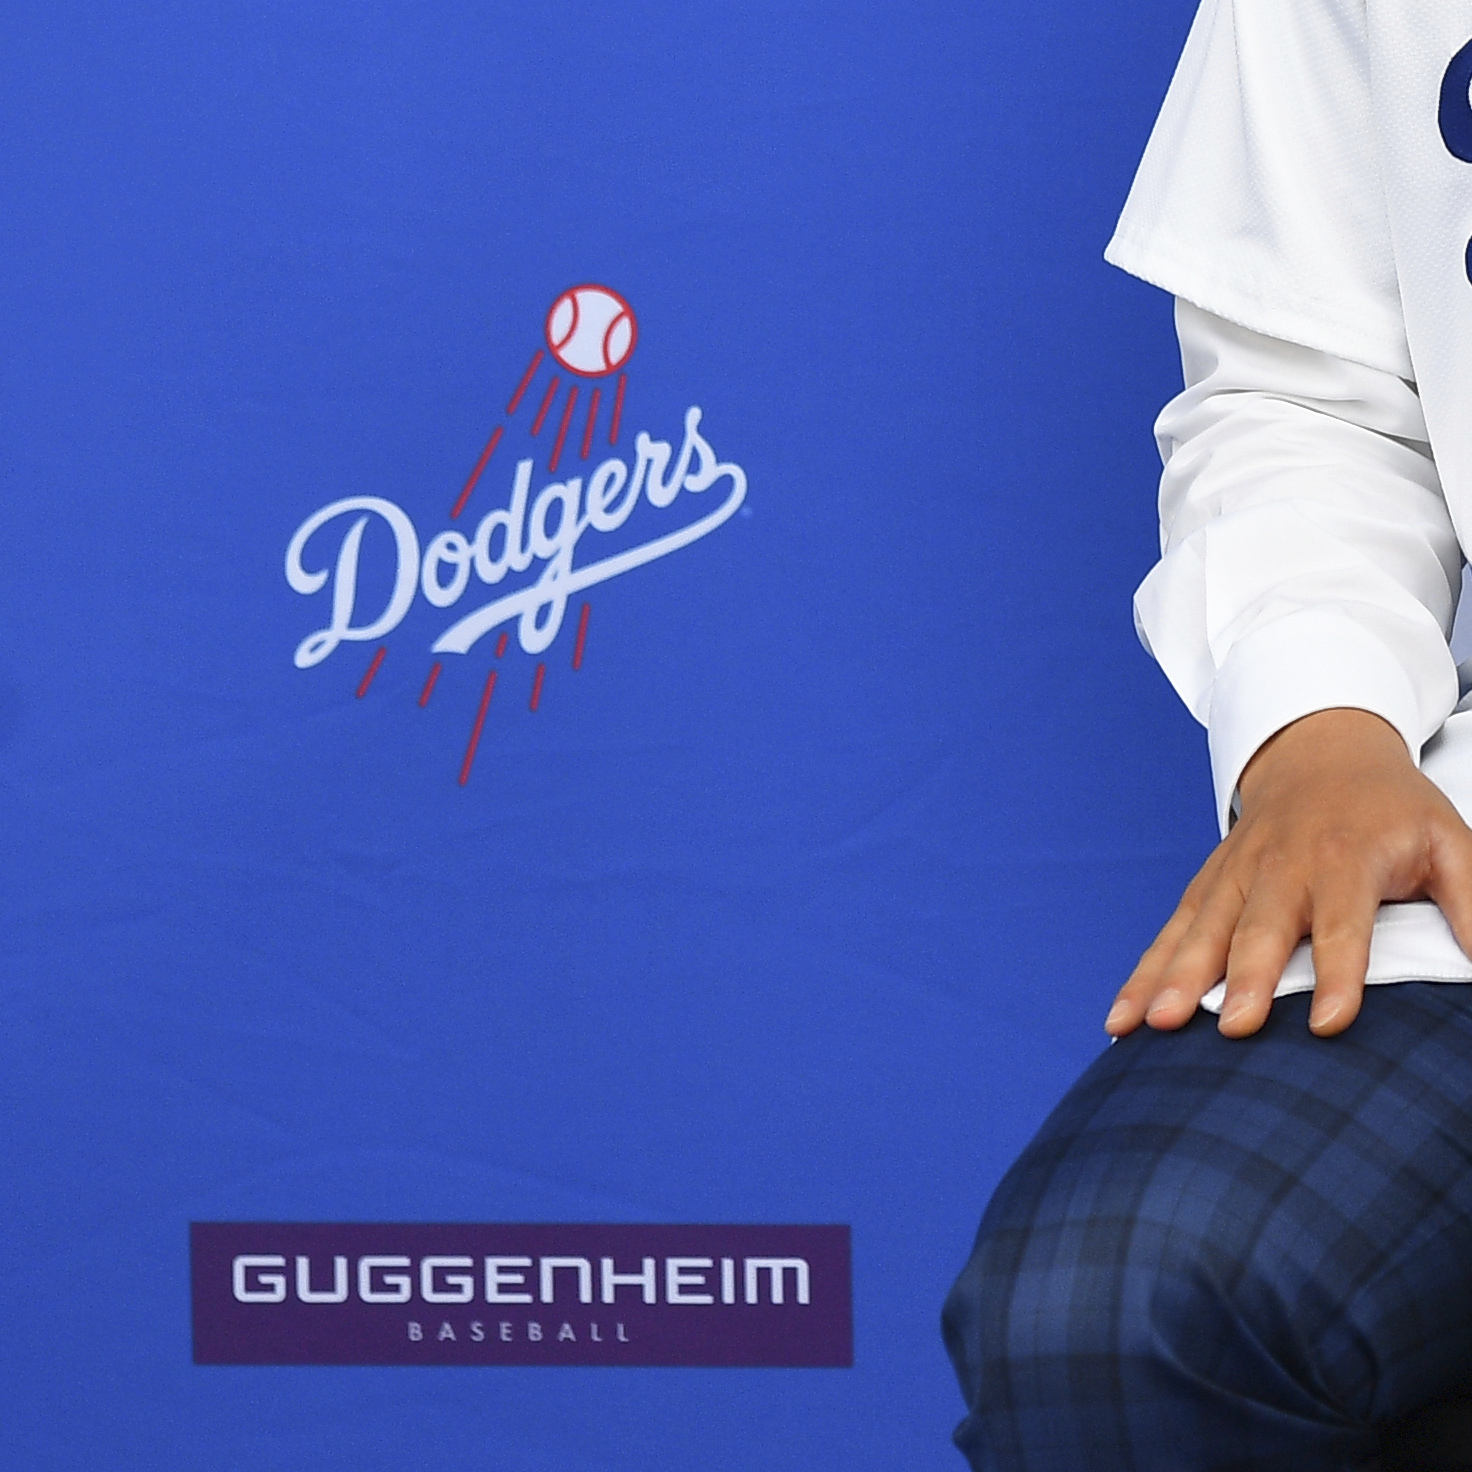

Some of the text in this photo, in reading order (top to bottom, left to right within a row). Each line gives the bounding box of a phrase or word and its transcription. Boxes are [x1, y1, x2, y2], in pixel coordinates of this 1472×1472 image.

[285, 406, 748, 669] Dodgers
[232, 1255, 811, 1305] GUGGENHEIM
[407, 1321, 630, 1343] BASEBALL
